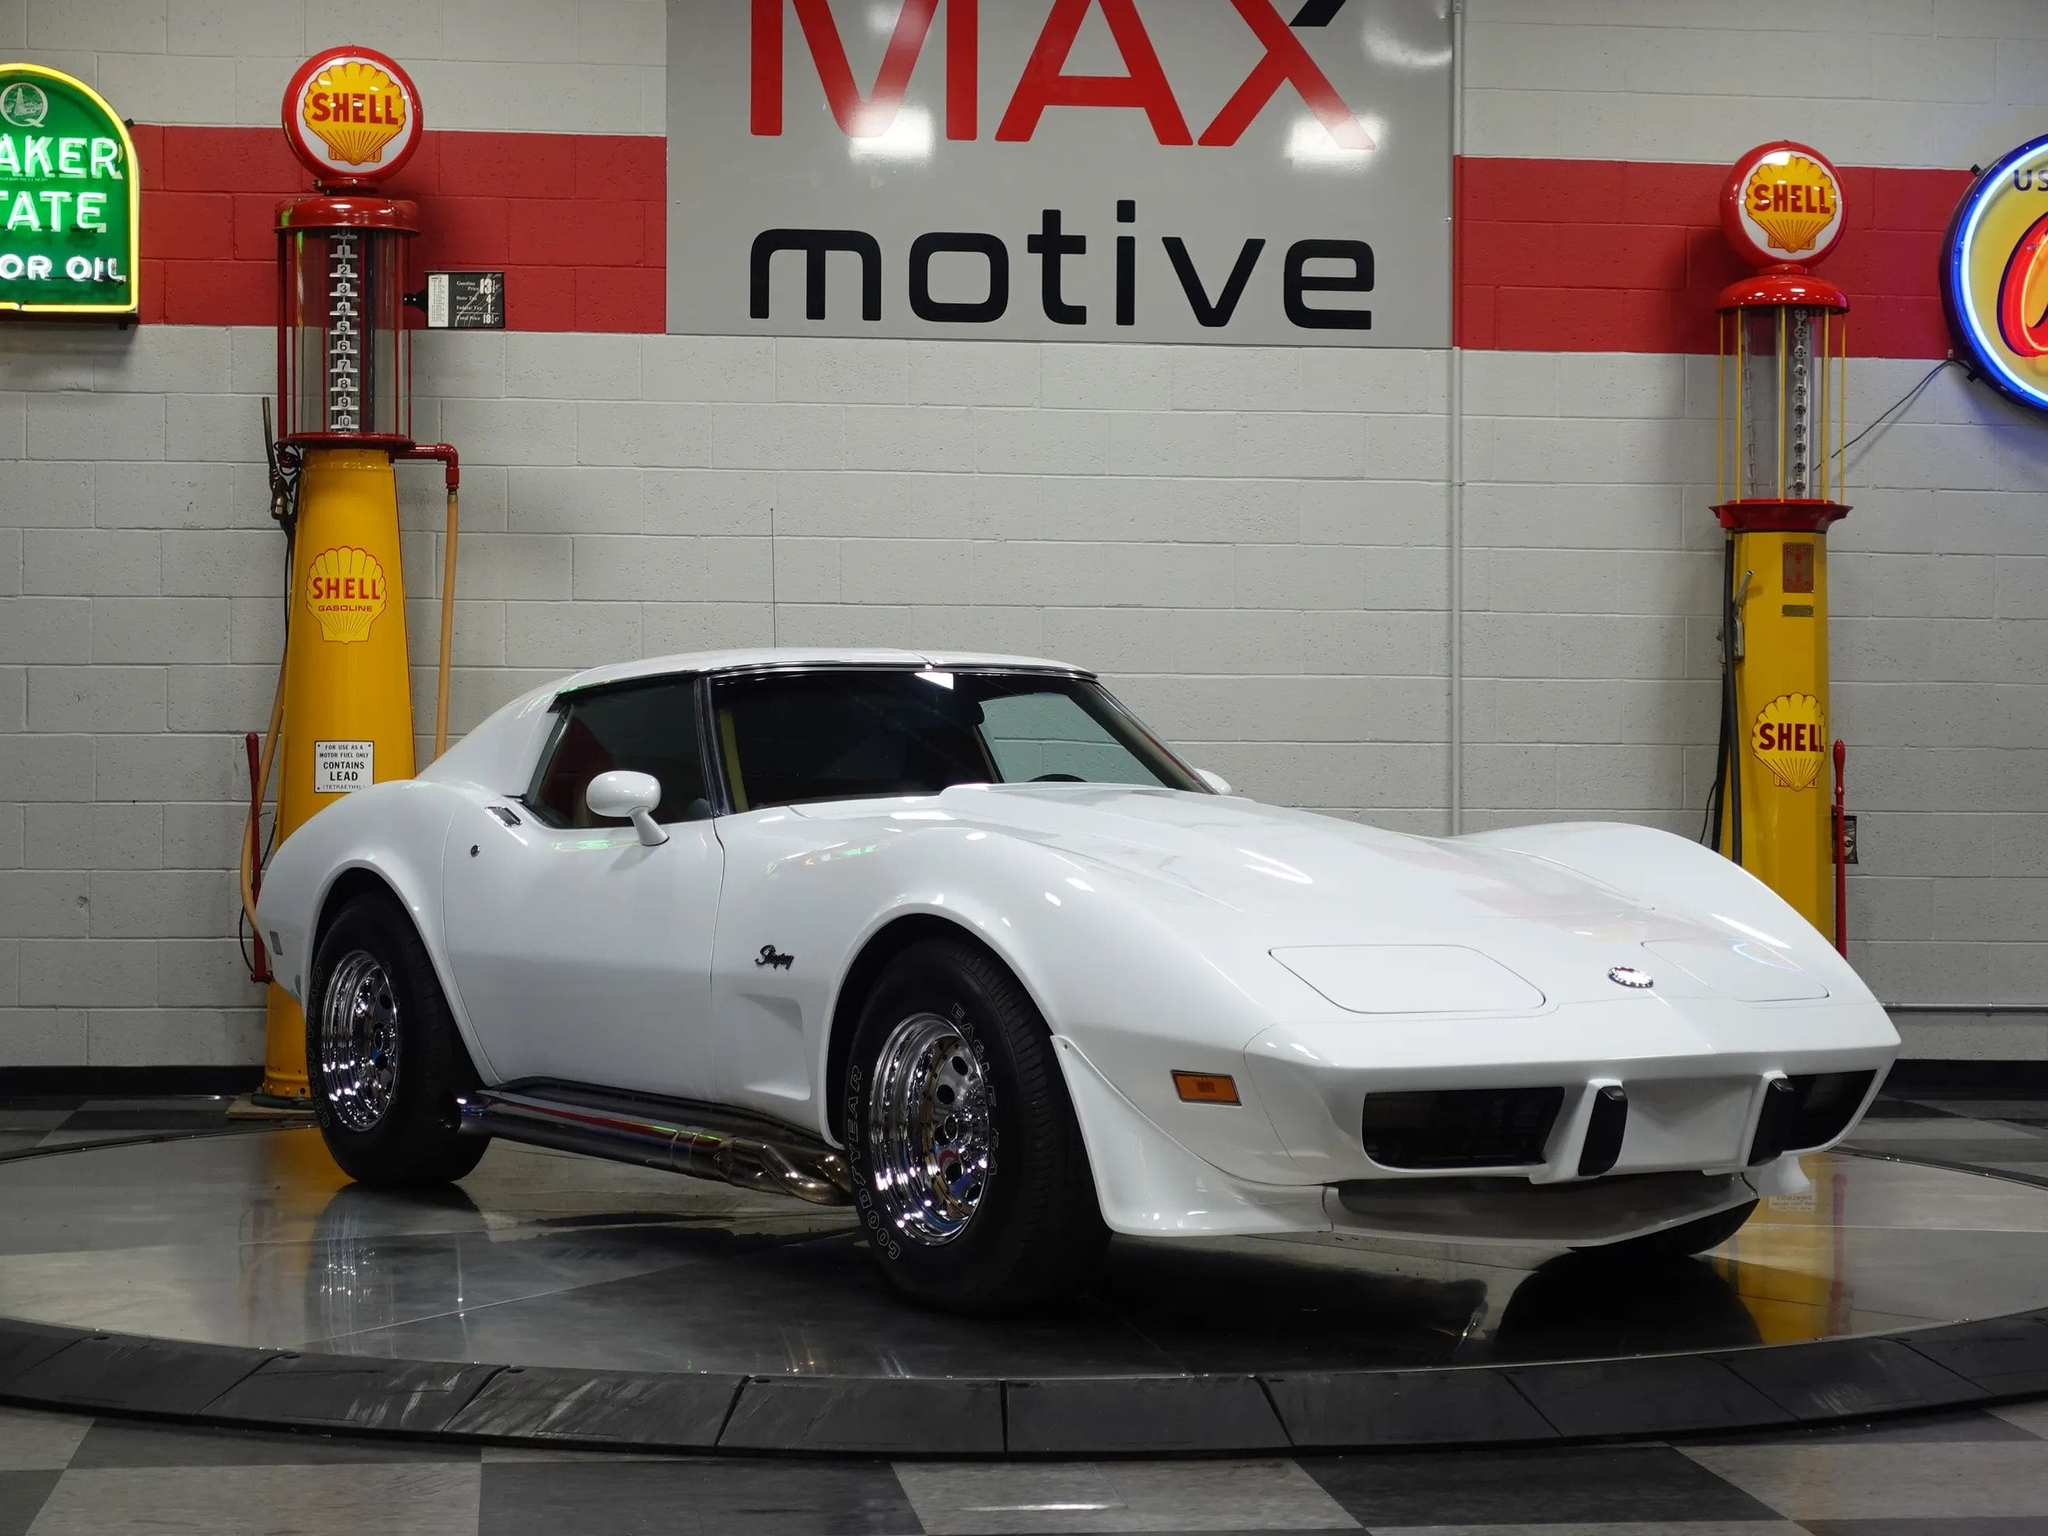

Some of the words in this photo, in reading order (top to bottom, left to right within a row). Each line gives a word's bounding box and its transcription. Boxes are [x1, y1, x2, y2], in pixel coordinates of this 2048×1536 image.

[749, 0, 1375, 150] MAX
[311, 92, 399, 125] SHELL
[1753, 184, 1831, 214] SHELL
[0, 190, 107, 233] ATE
[66, 255, 126, 283] OIL
[749, 199, 1376, 330] motive
[340, 266, 348, 274] 2
[340, 284, 347, 294] 3
[339, 304, 346, 313] 4
[340, 322, 347, 332] 5
[340, 342, 347, 351] 6
[340, 361, 347, 370] 7
[340, 380, 348, 389] 8
[341, 398, 348, 407] 9
[340, 417, 350, 426] 10
[312, 576, 380, 600] SHELL
[1758, 722, 1824, 752] SHELL
[330, 772, 358, 781] LEAD
